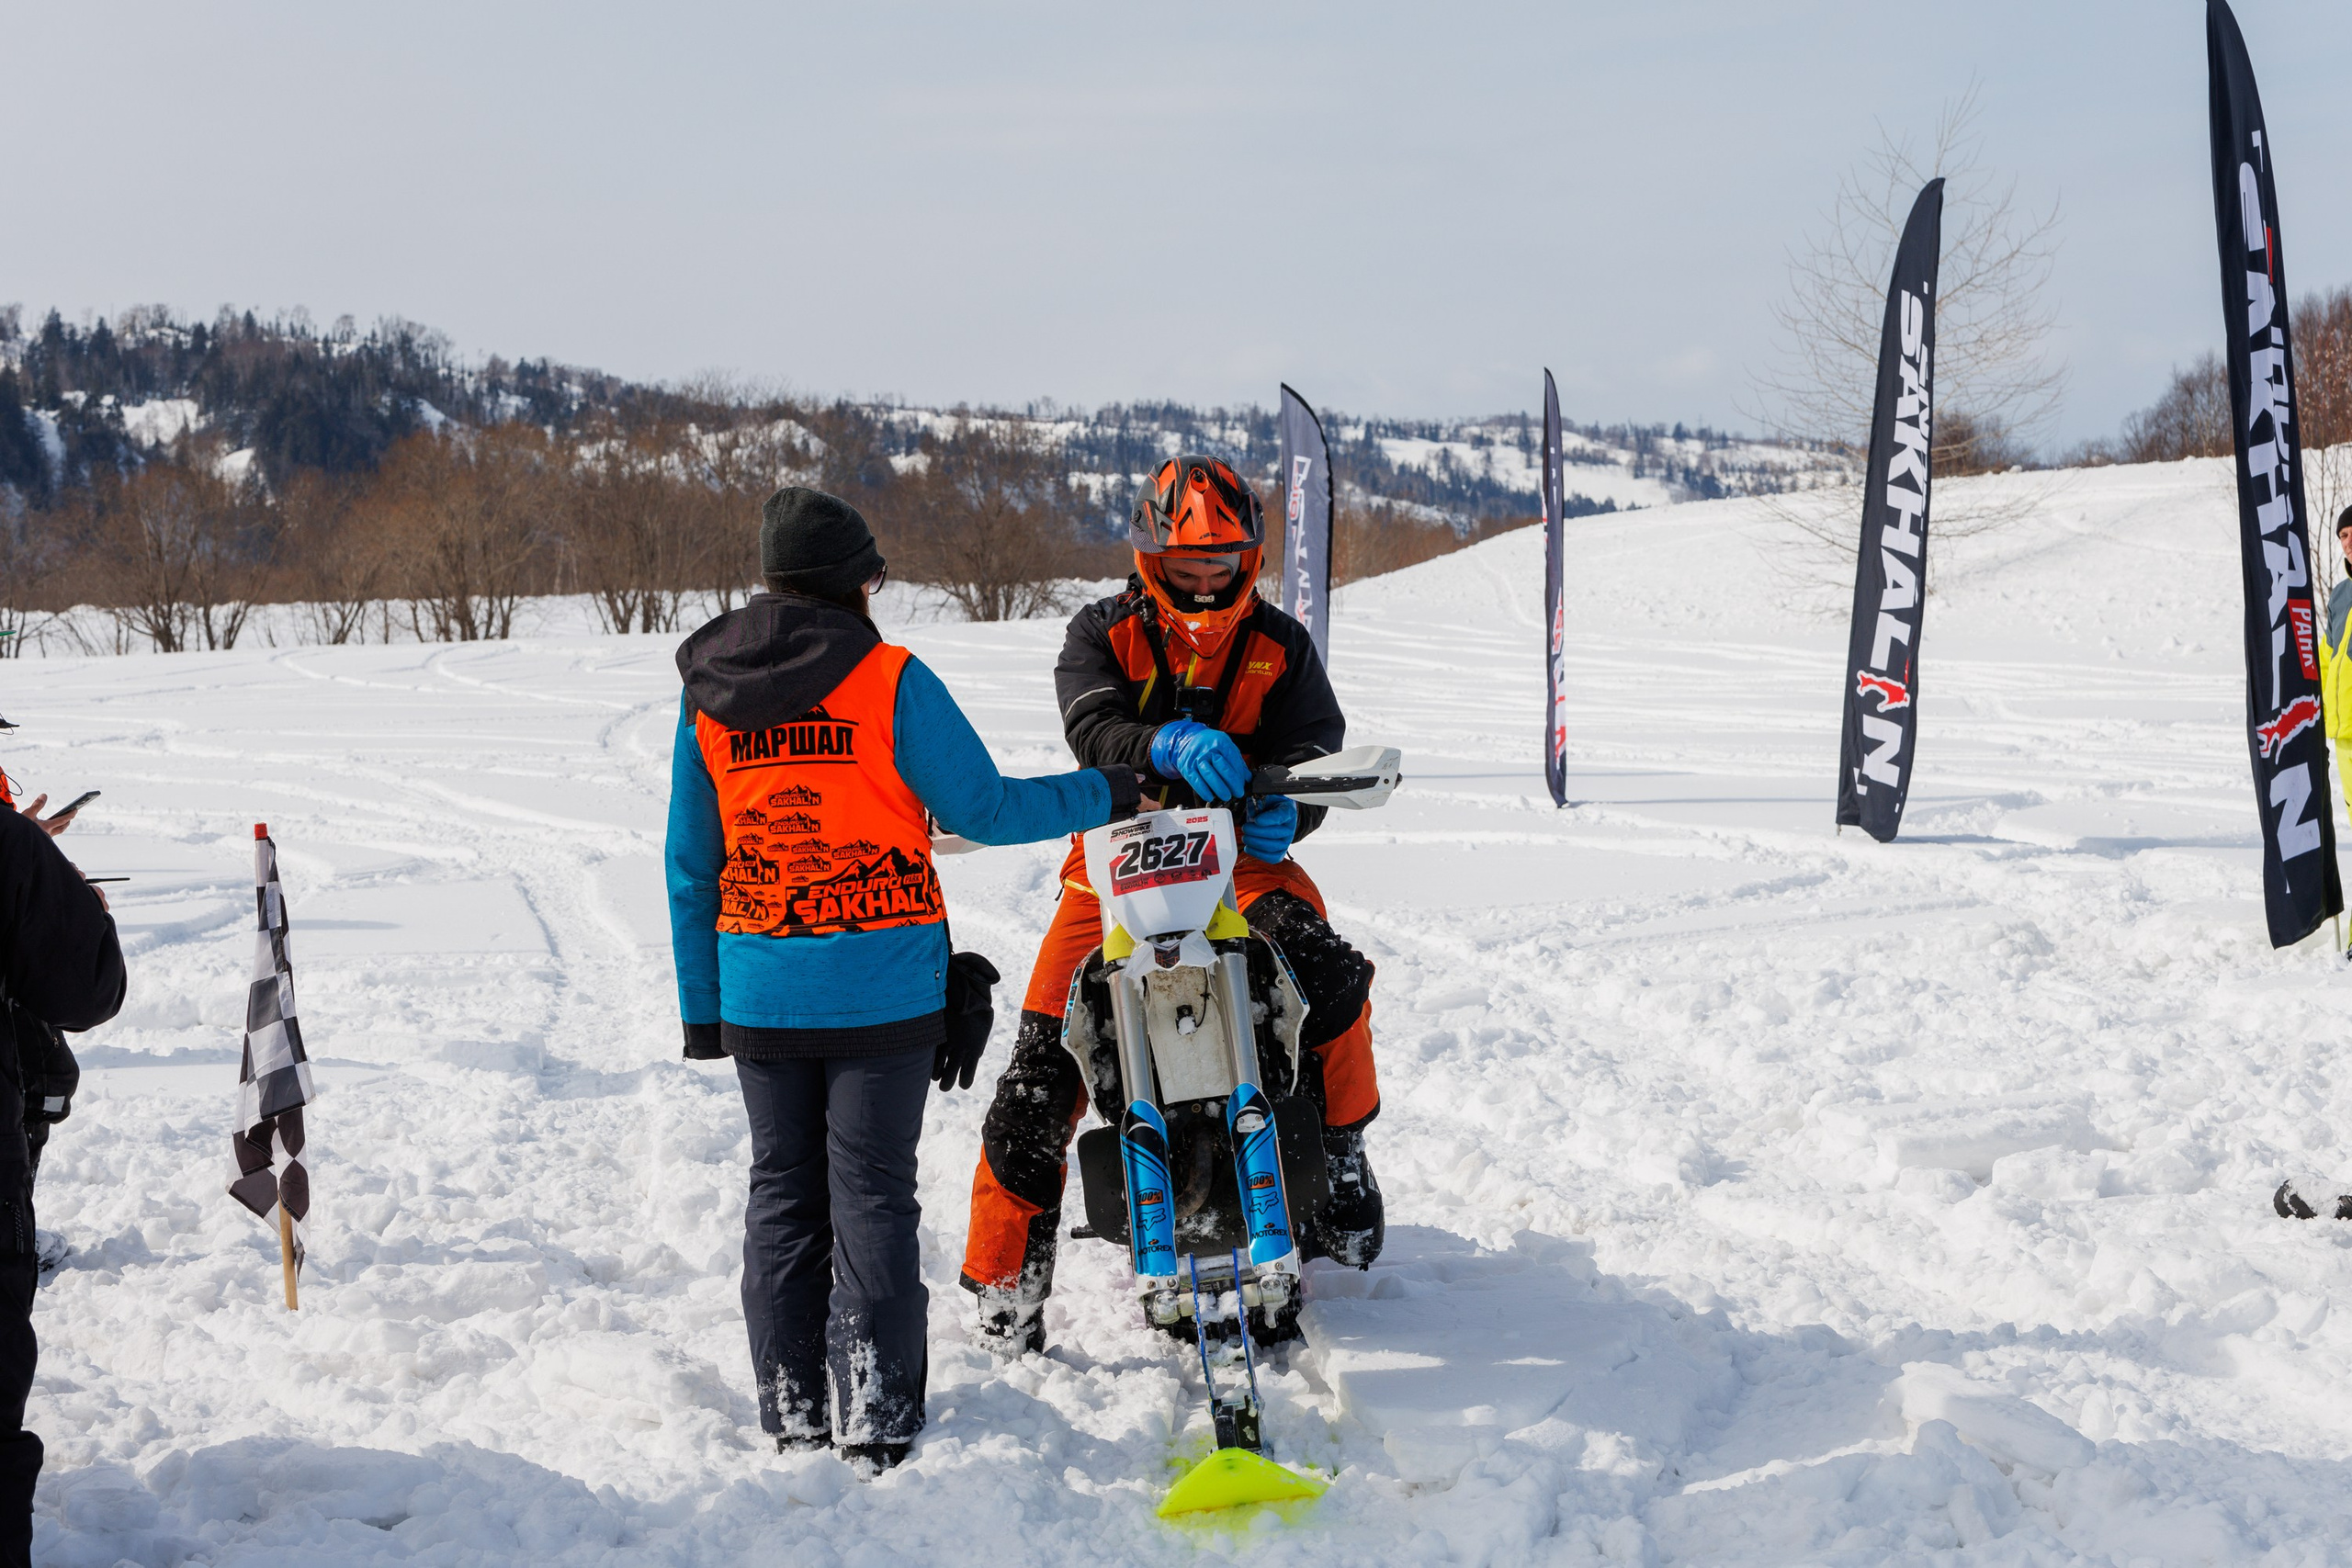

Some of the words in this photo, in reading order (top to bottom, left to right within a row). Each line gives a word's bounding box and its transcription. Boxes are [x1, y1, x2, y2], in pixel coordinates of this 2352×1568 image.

[1248, 660, 1273, 671] YNX
[730, 726, 854, 763] МАРШАЛ
[1186, 816, 1209, 824] 2025
[1117, 831, 1210, 877] 2627
[808, 876, 902, 900] ENDURO
[905, 874, 921, 884] PARK
[1249, 1175, 1272, 1188] 100%
[1137, 1190, 1161, 1202] 100%
[1251, 1229, 1288, 1240] MOTOREX
[1137, 1245, 1173, 1256] MOTOREX
